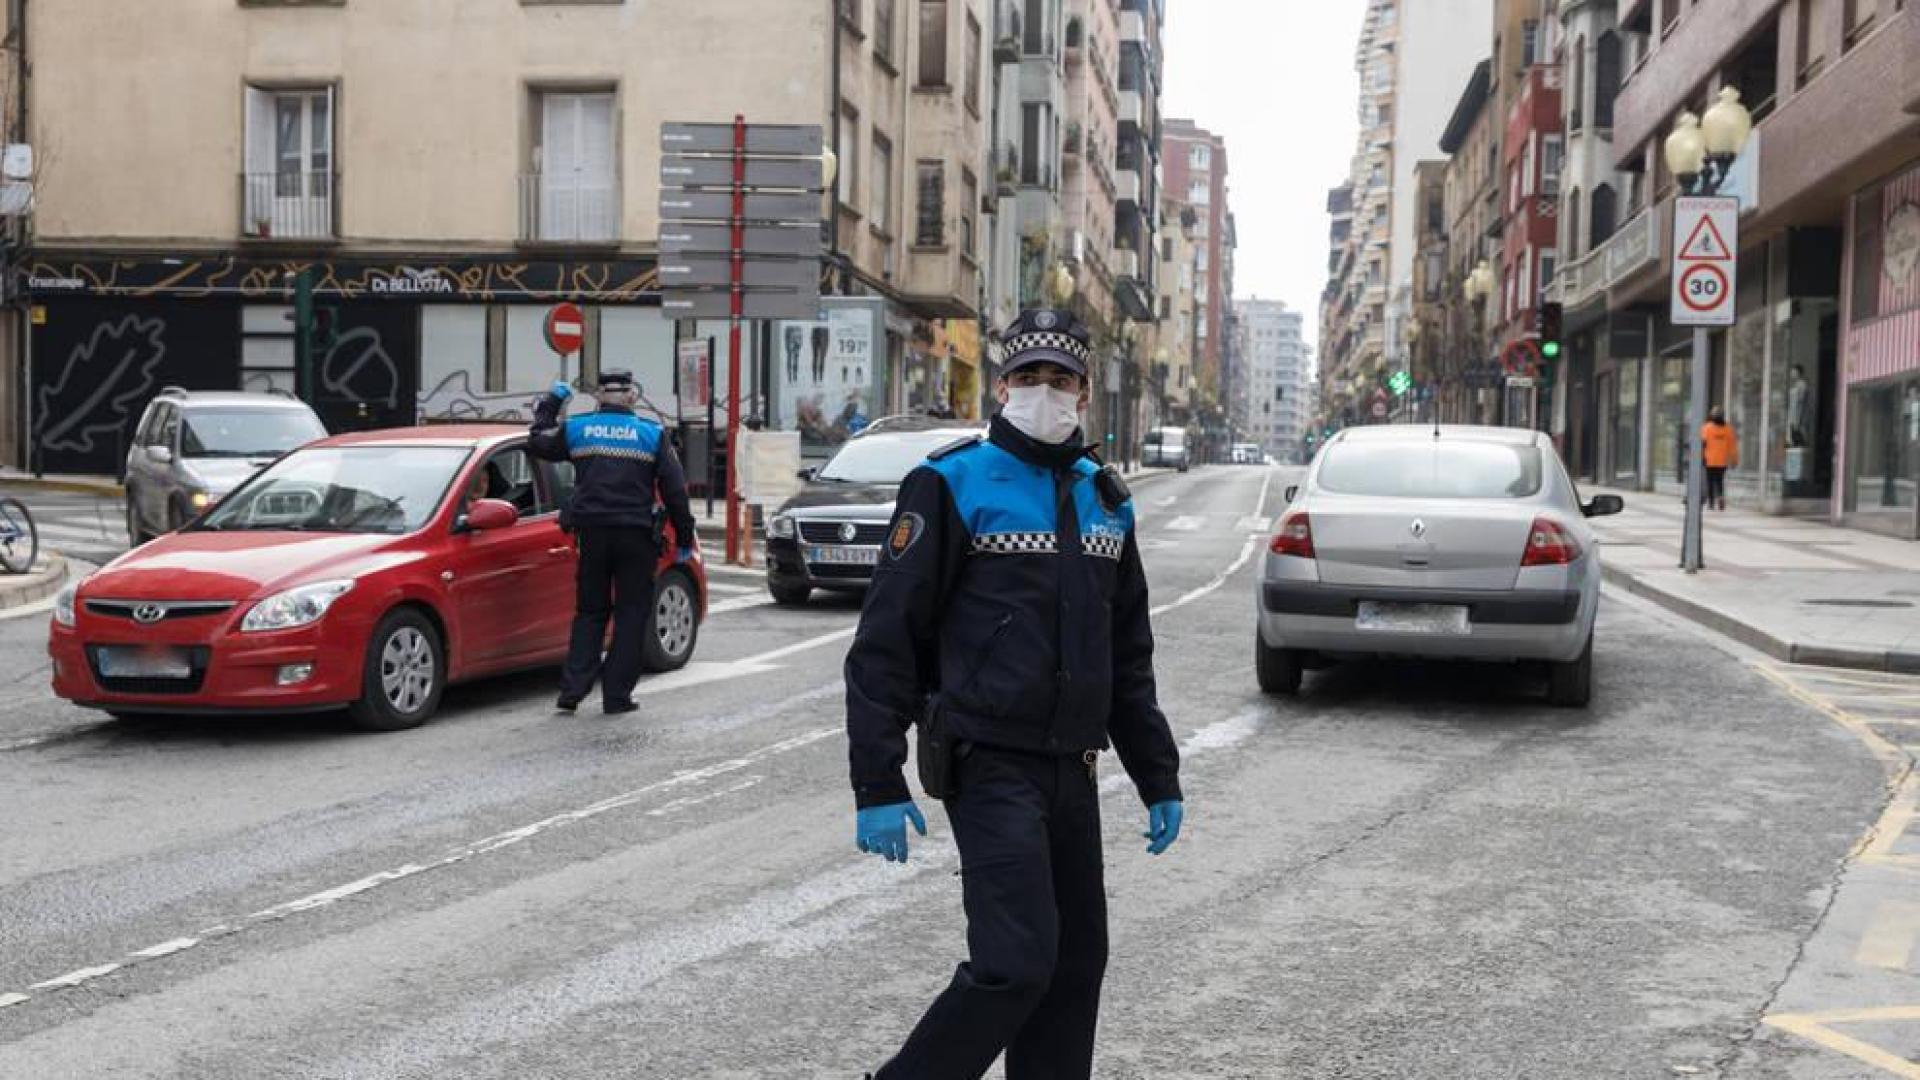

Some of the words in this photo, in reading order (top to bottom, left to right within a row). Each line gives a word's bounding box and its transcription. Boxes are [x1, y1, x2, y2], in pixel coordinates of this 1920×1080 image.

[389, 278, 453, 293] BELLOTA
[1689, 278, 1718, 296] 30
[583, 424, 639, 441] POLICÍA
